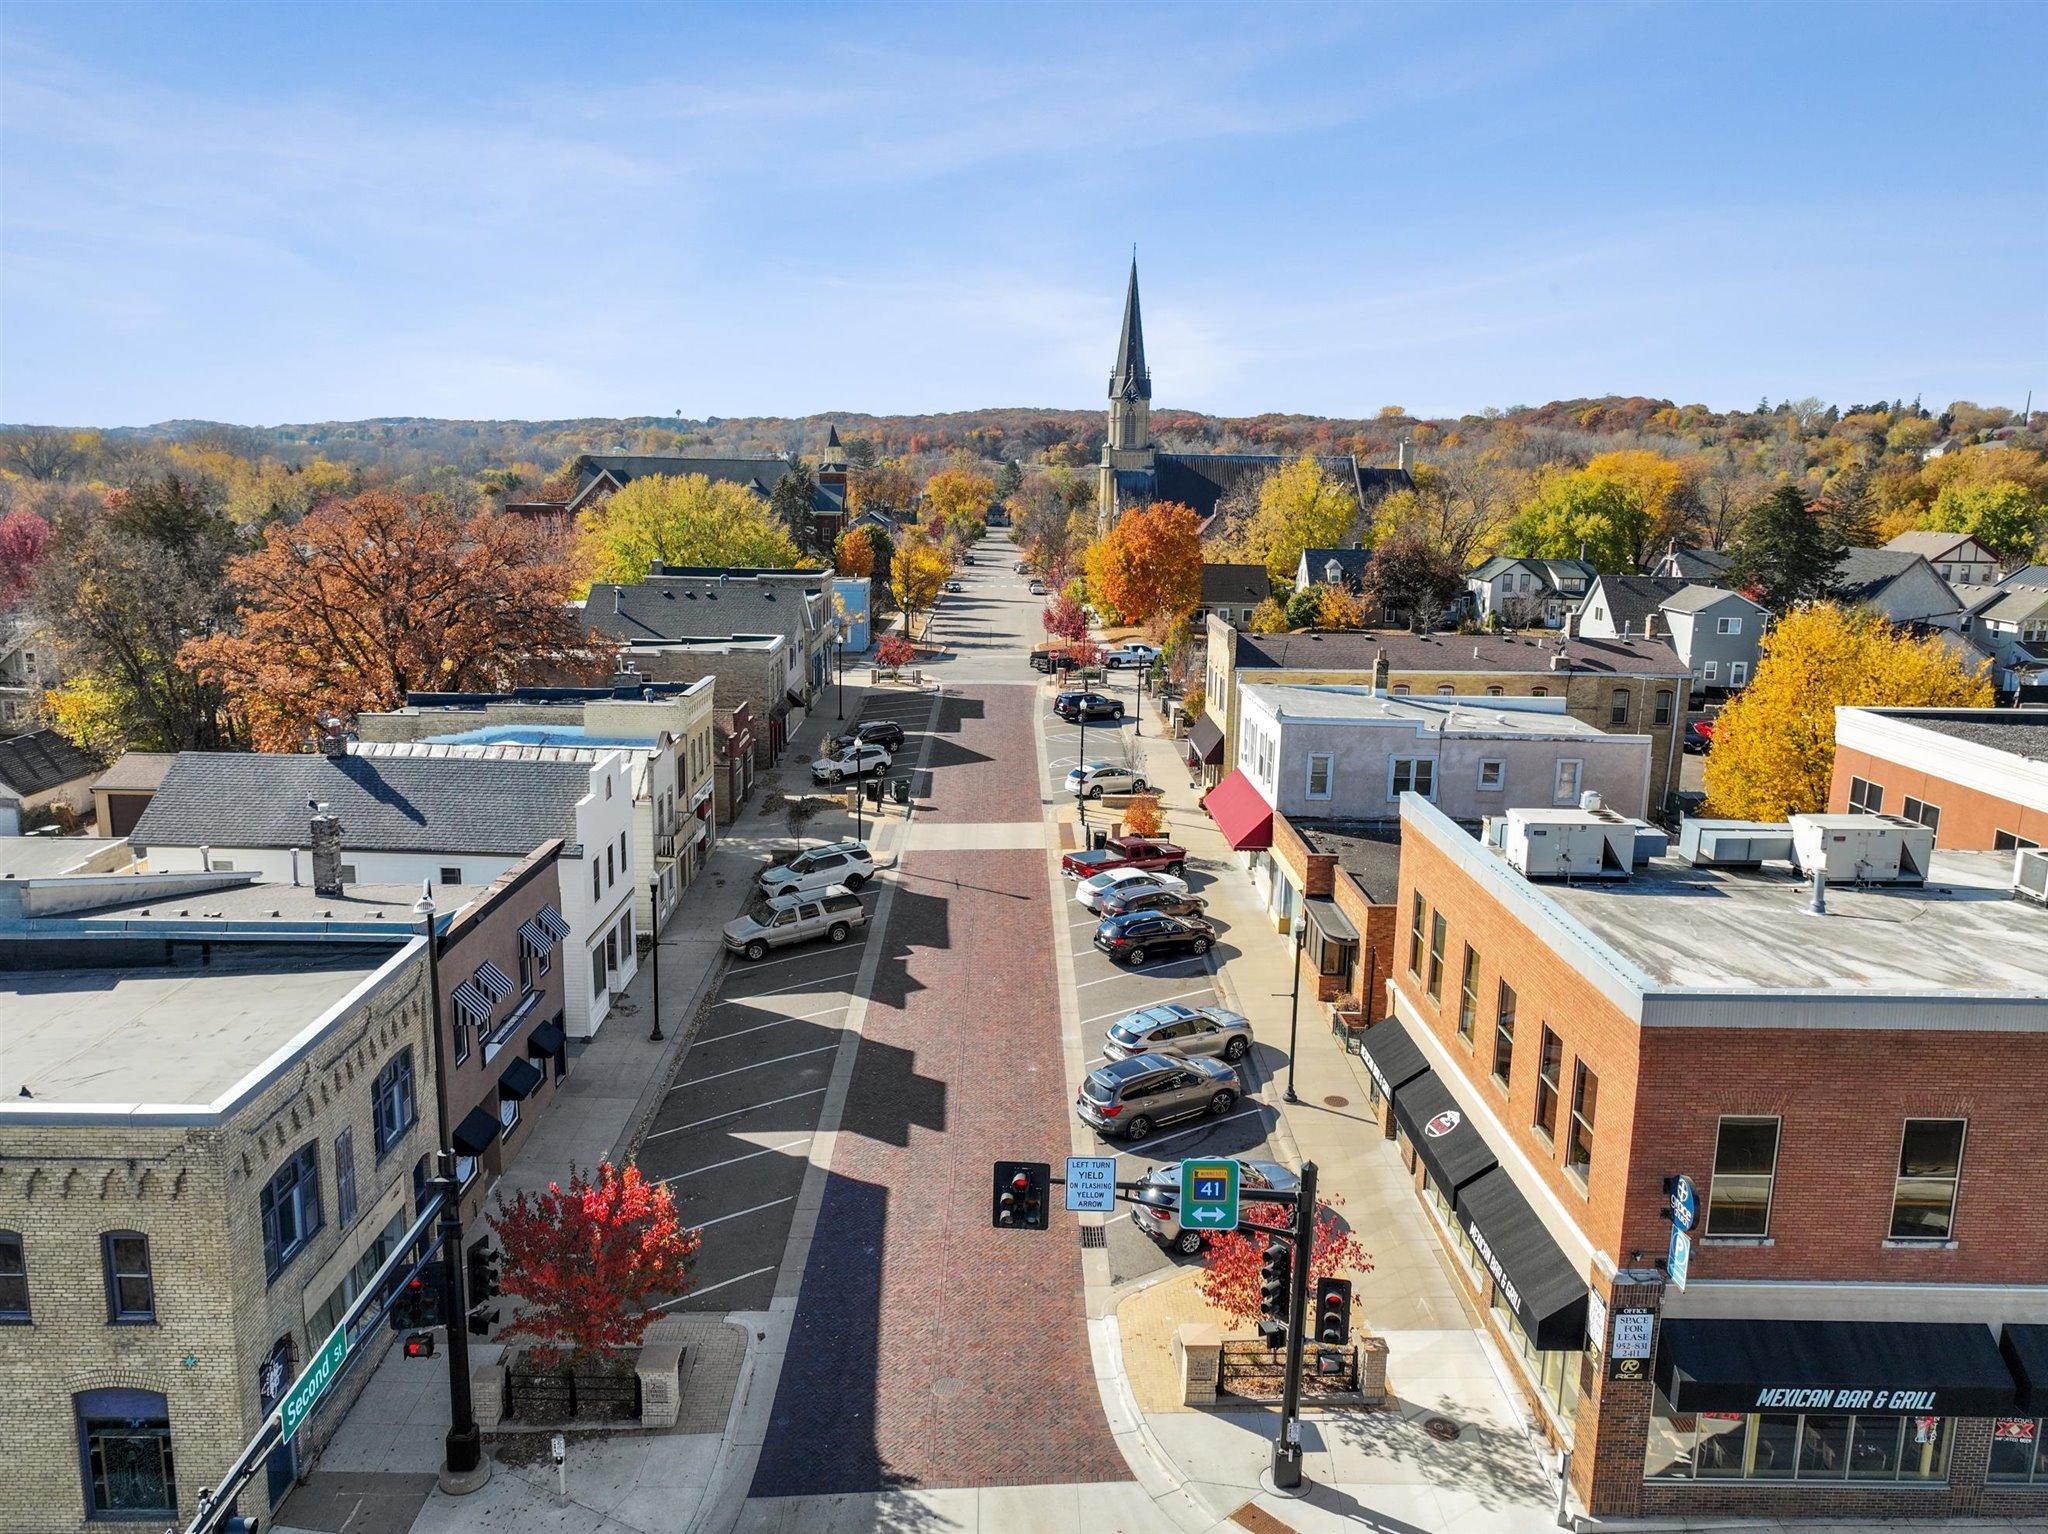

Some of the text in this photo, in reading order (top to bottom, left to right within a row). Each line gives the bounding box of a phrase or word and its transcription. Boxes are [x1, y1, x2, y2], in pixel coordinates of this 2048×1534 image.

[1092, 1161, 1111, 1169] TURN
[1079, 1171, 1104, 1180] YIELD
[1200, 1182, 1220, 1196] 41
[1077, 1191, 1105, 1199] YELLOW
[1078, 1200, 1103, 1208] ARROW
[1671, 1194, 1692, 1222] grace
[1469, 1220, 1521, 1315] MEXICAN BAR & GRILL
[1620, 1316, 1649, 1324] SPACE
[1624, 1325, 1644, 1333] FOR
[1617, 1333, 1649, 1341] LEASE
[287, 1353, 330, 1426] Second
[1755, 1388, 1937, 1410] MEXICAN BAR & GRILL
